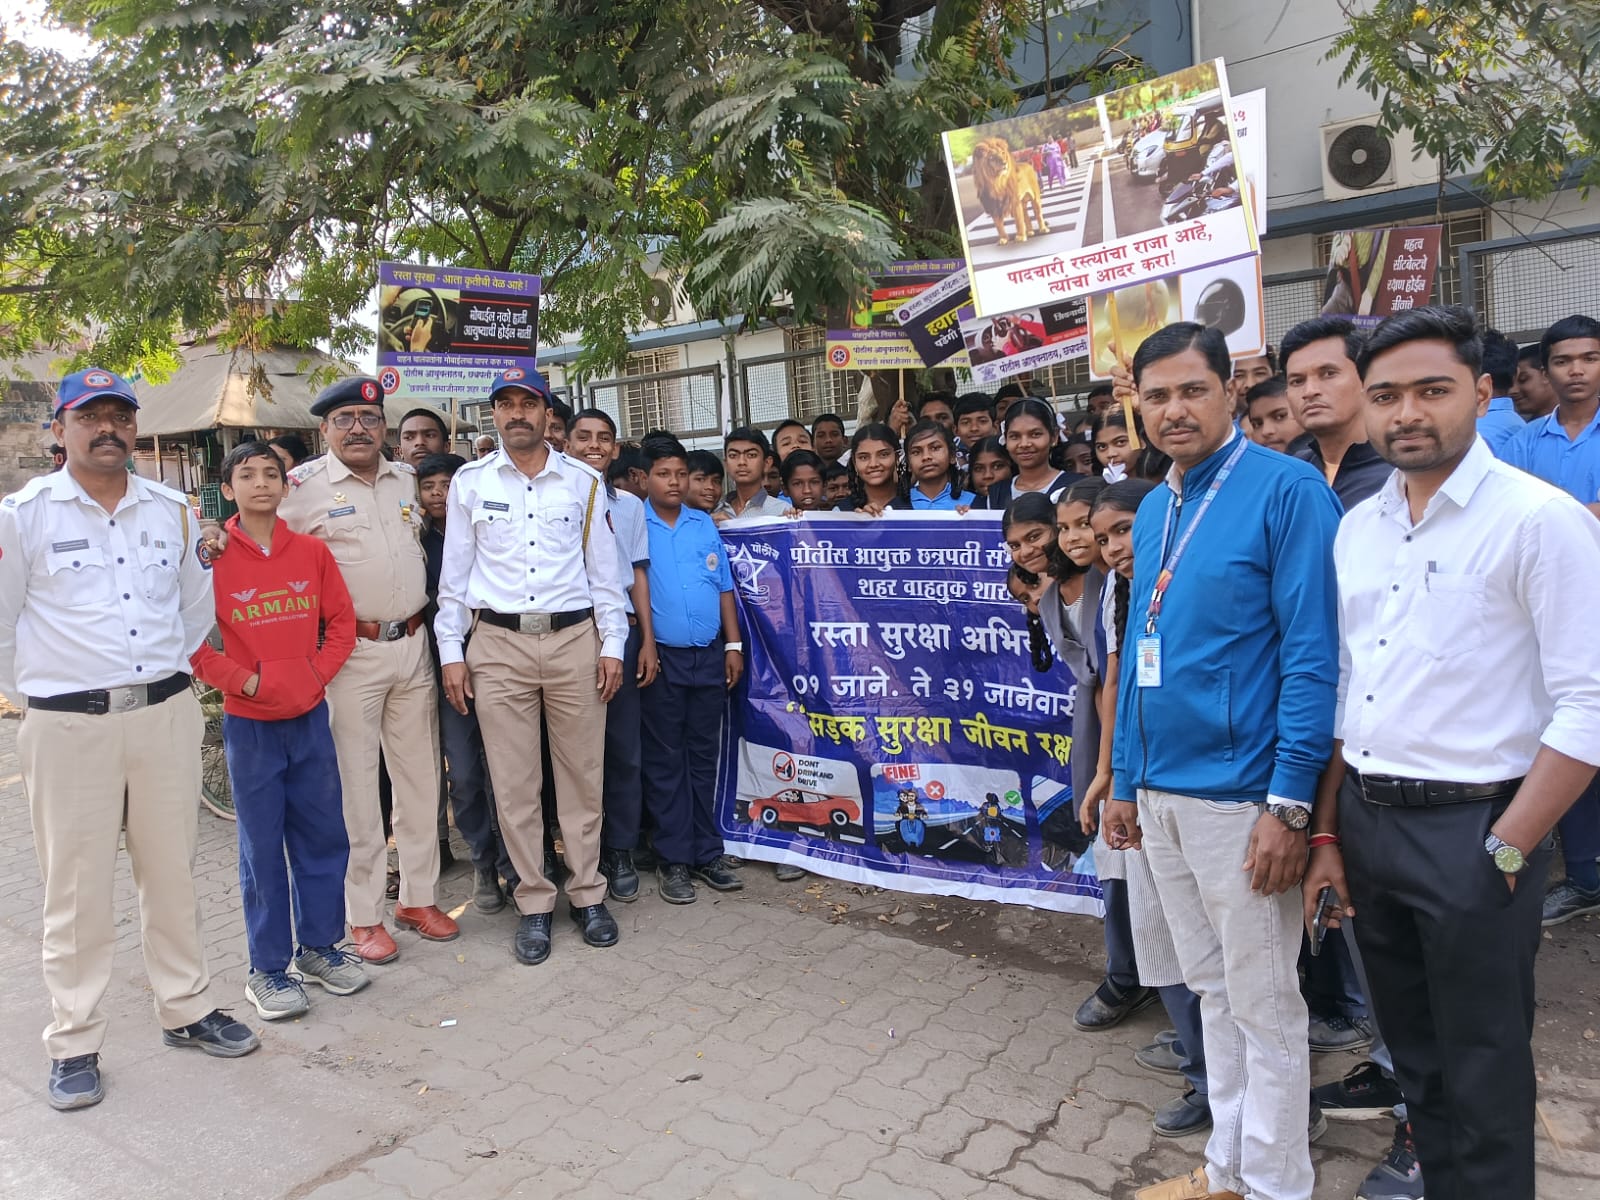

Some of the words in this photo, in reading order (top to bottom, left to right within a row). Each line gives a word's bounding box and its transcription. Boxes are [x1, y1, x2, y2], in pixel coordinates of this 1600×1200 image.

[1008, 257, 1064, 285] पादचारी
[1071, 243, 1127, 270] रस्त्यांचा
[1134, 234, 1168, 255] राजा
[1175, 221, 1212, 243] आहे,
[443, 275, 463, 285] आता
[1048, 269, 1089, 295] त्यांचा
[1097, 262, 1133, 284] आदर
[1143, 250, 1176, 272] करा!
[1405, 275, 1426, 293] होईल
[470, 305, 495, 323] मोबाईल
[496, 308, 511, 323] नको
[512, 309, 528, 325] हाती
[497, 324, 516, 340] होईल
[790, 540, 848, 566] पोलीस
[854, 545, 911, 572] आयुक्त
[917, 541, 982, 567] छत्रपती
[858, 577, 898, 599] शहर
[902, 578, 968, 603] वाहतुक
[231, 594, 318, 624] ARMANI
[810, 621, 870, 649] रस्ता
[877, 620, 951, 660] सुरक्षा
[792, 673, 820, 695] ०१
[831, 666, 899, 697] जाने.
[911, 666, 932, 697] ते
[944, 677, 974, 701] ३१
[877, 715, 952, 755] सुरक्षा
[960, 711, 1030, 756] जीवन
[798, 759, 820, 768] DONT
[886, 765, 918, 779] FINE
[797, 777, 818, 787] DRIVE
